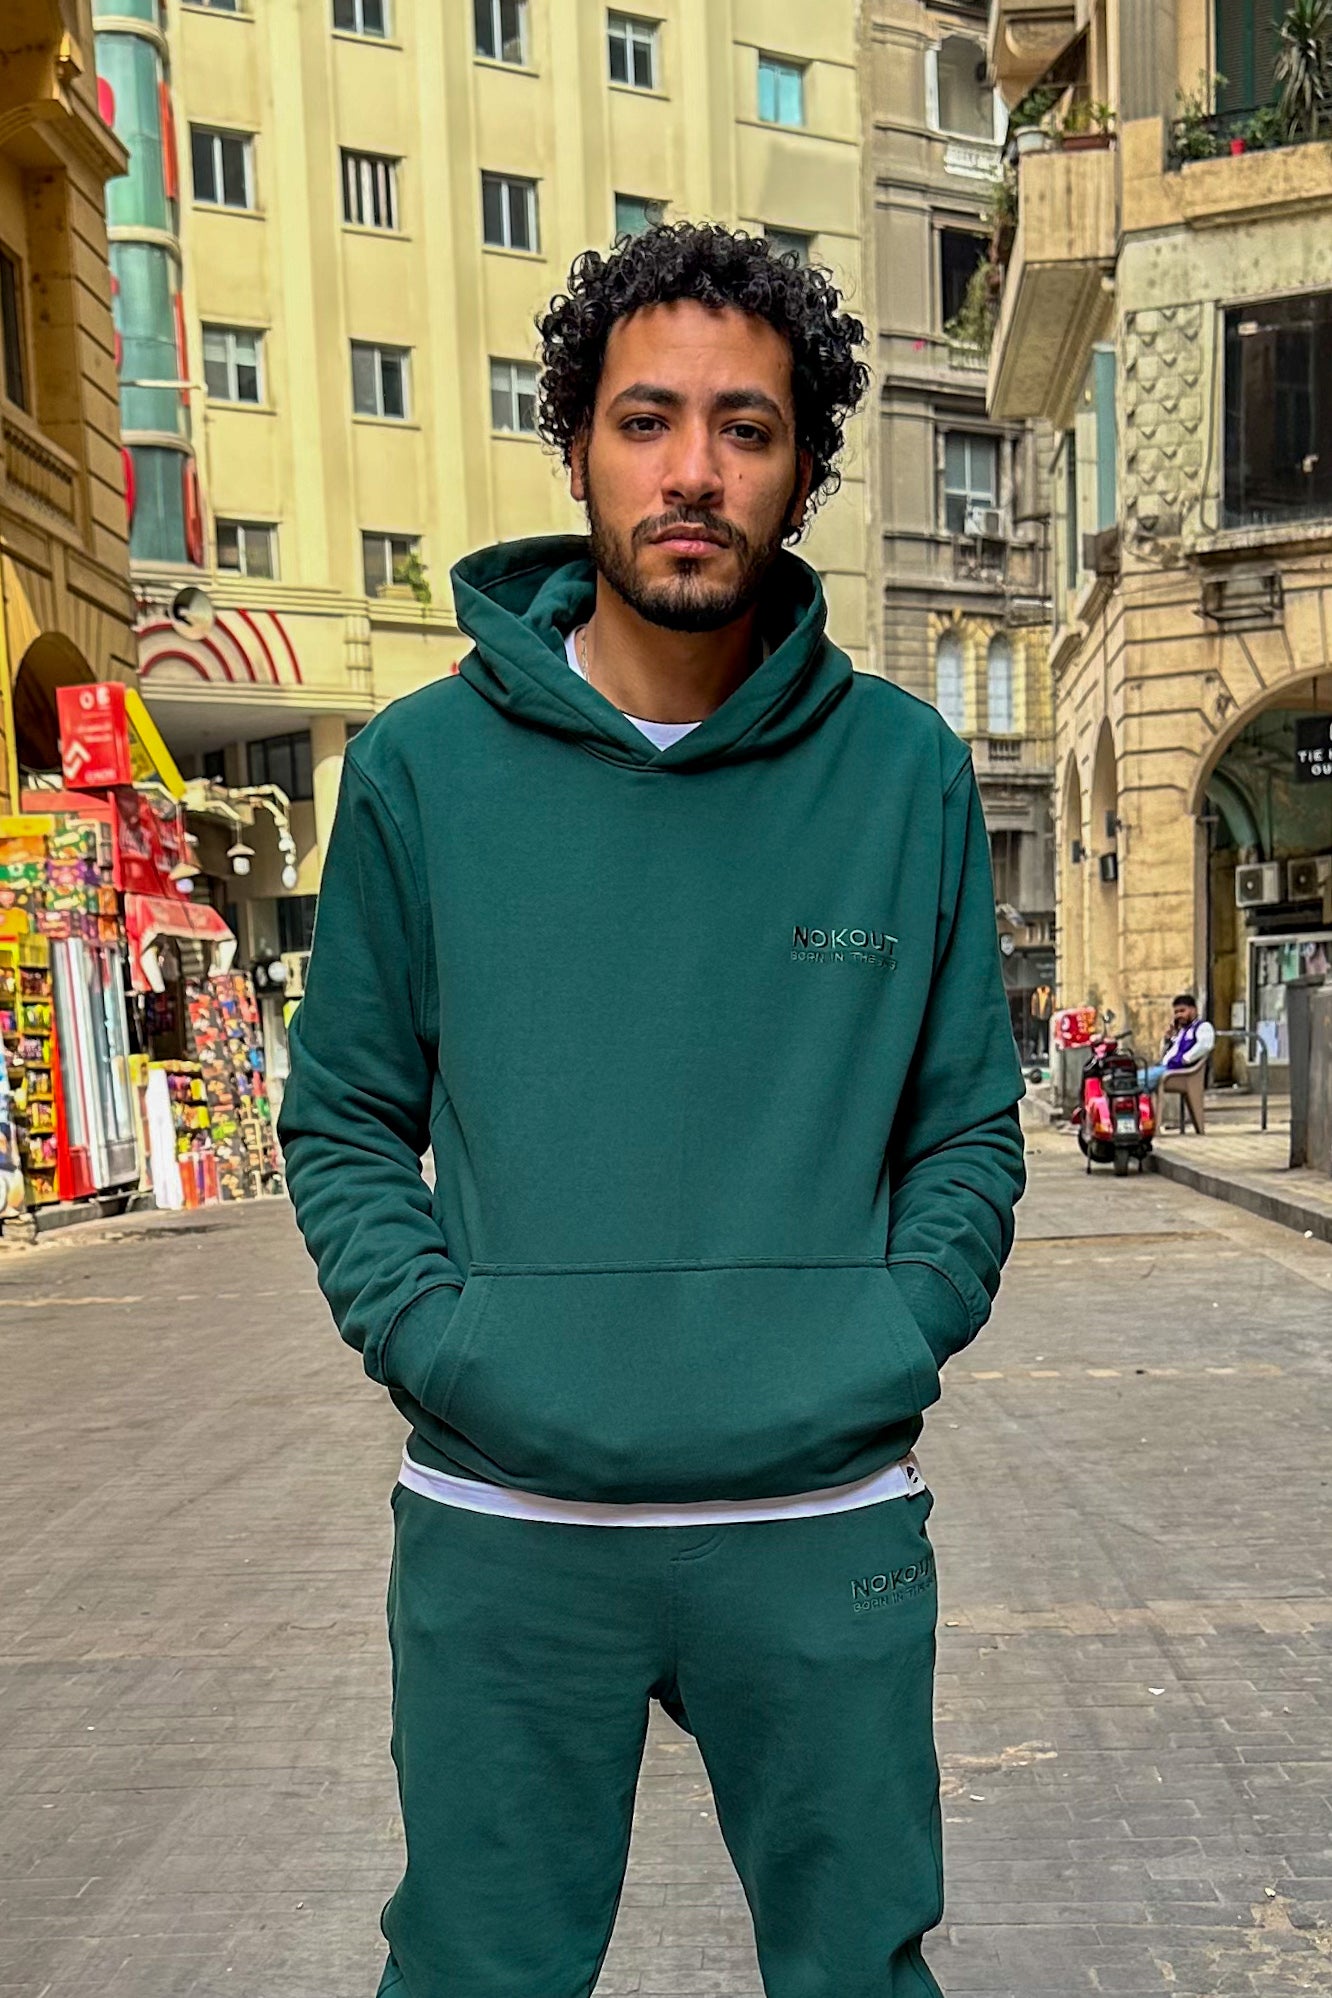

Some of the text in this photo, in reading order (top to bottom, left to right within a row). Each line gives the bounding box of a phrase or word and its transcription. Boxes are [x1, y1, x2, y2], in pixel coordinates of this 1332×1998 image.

[793, 925, 899, 955] NOKOUT
[790, 950, 824, 963] BORN
[830, 951, 844, 962] IN
